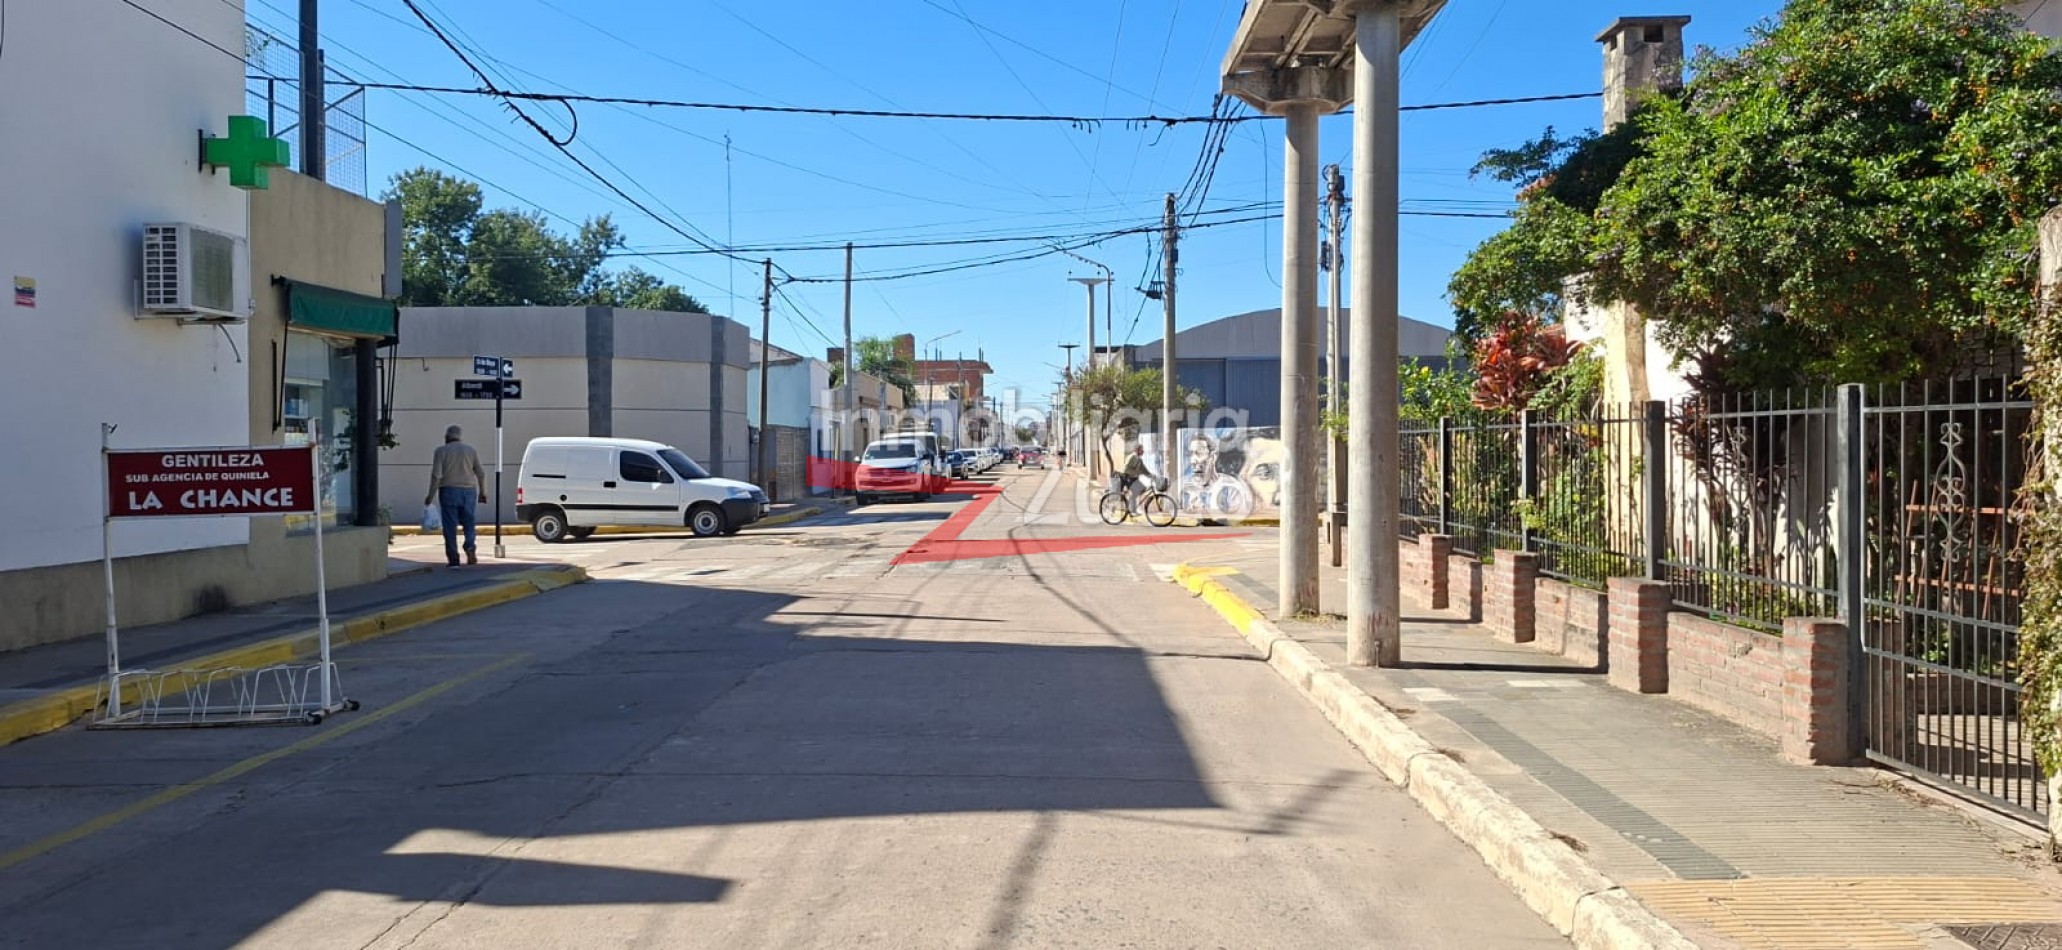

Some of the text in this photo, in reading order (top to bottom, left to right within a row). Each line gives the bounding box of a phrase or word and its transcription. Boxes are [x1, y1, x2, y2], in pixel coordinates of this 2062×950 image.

[161, 453, 264, 468] GENTILEZA
[125, 471, 270, 483] SUB AGENCIA DE QUINIELA
[128, 487, 295, 511] LA CHANCE
